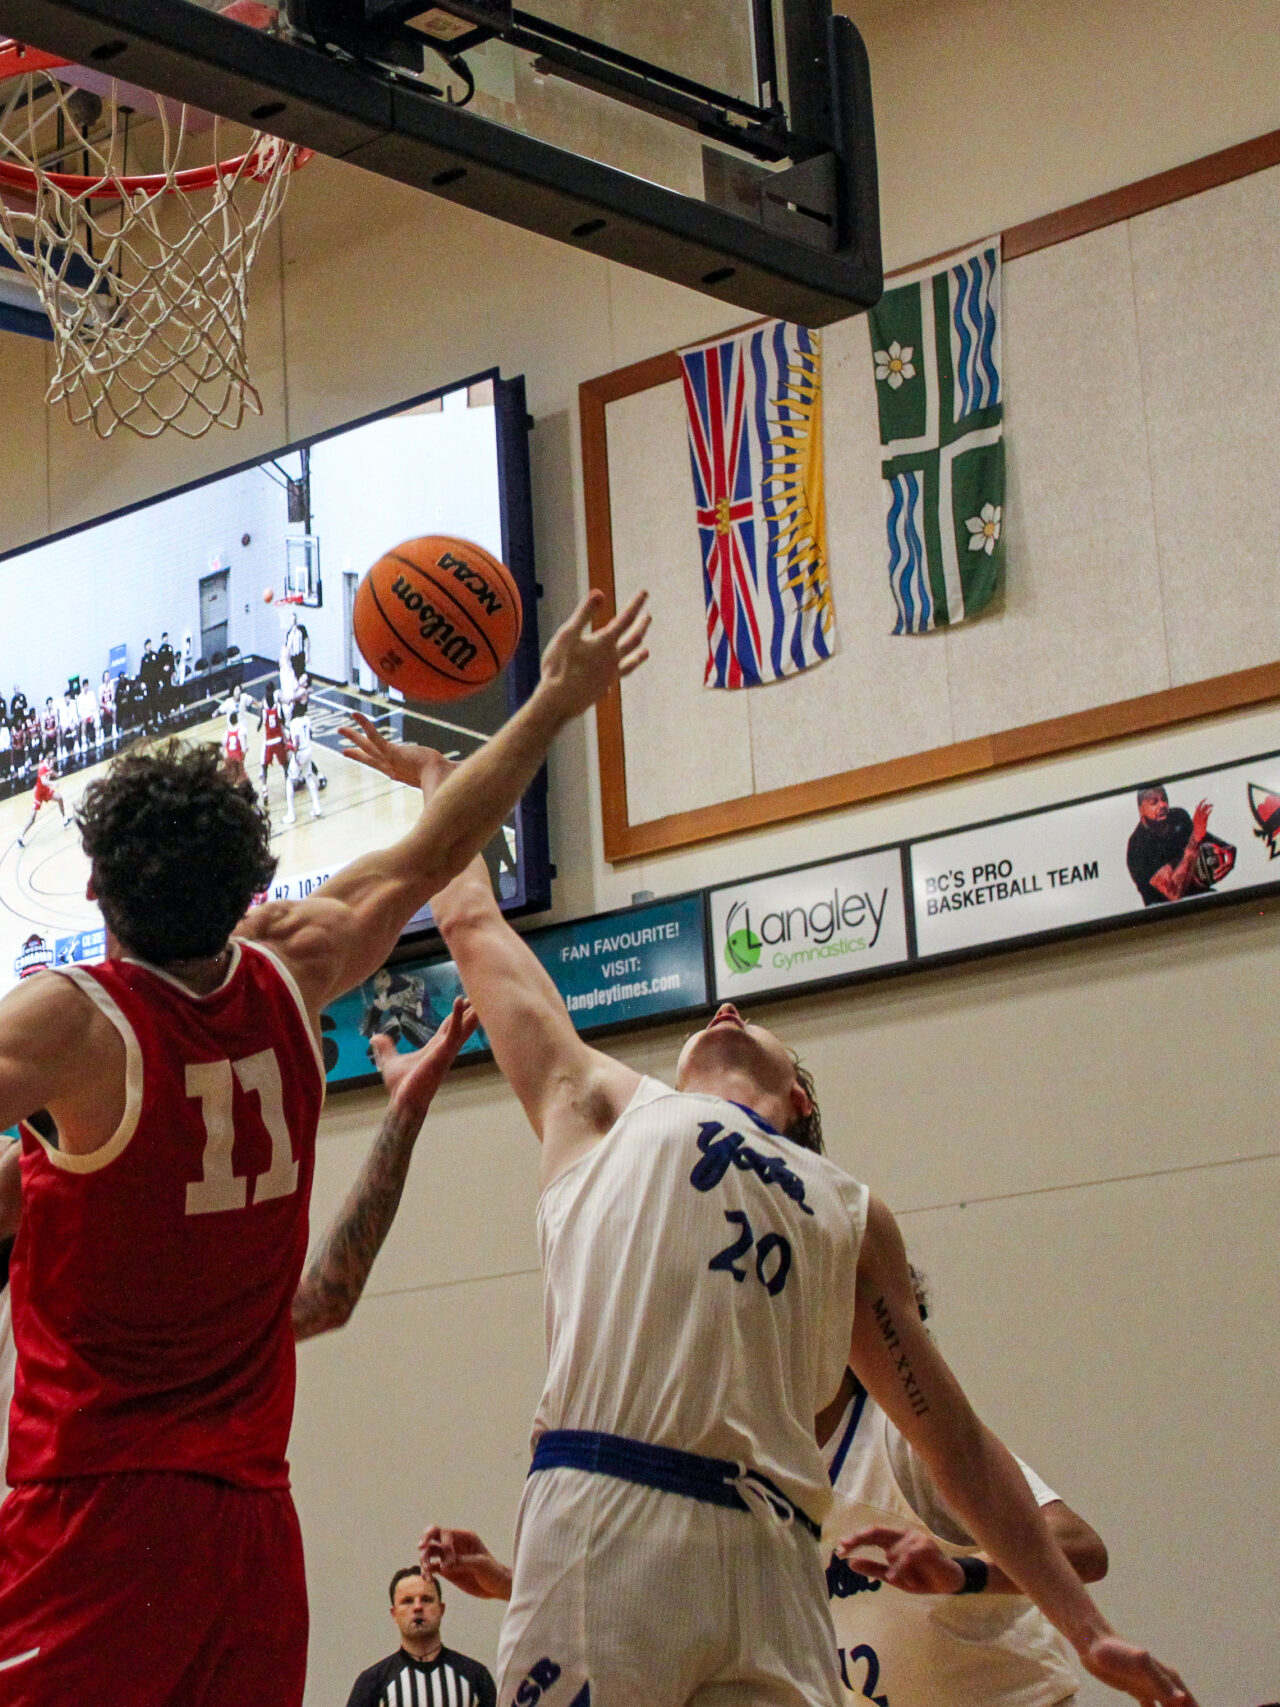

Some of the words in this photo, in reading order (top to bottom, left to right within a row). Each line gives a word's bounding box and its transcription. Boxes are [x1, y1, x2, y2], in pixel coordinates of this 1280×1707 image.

[435, 552, 503, 616] NCAA
[391, 575, 478, 670] Wilson
[925, 870, 965, 894] BC'S
[972, 859, 1013, 884] PRO
[927, 875, 1042, 916] BASKETBALL
[1046, 861, 1099, 888] TEAM
[562, 943, 590, 961] FAN
[594, 922, 680, 955] FAVOURITE!
[745, 888, 888, 950] Langley
[601, 957, 641, 978] VISIT:
[772, 937, 867, 971] Gymnastics
[566, 974, 680, 1011] langleytimes.com
[185, 1048, 299, 1215] 11
[709, 1210, 791, 1297] 20
